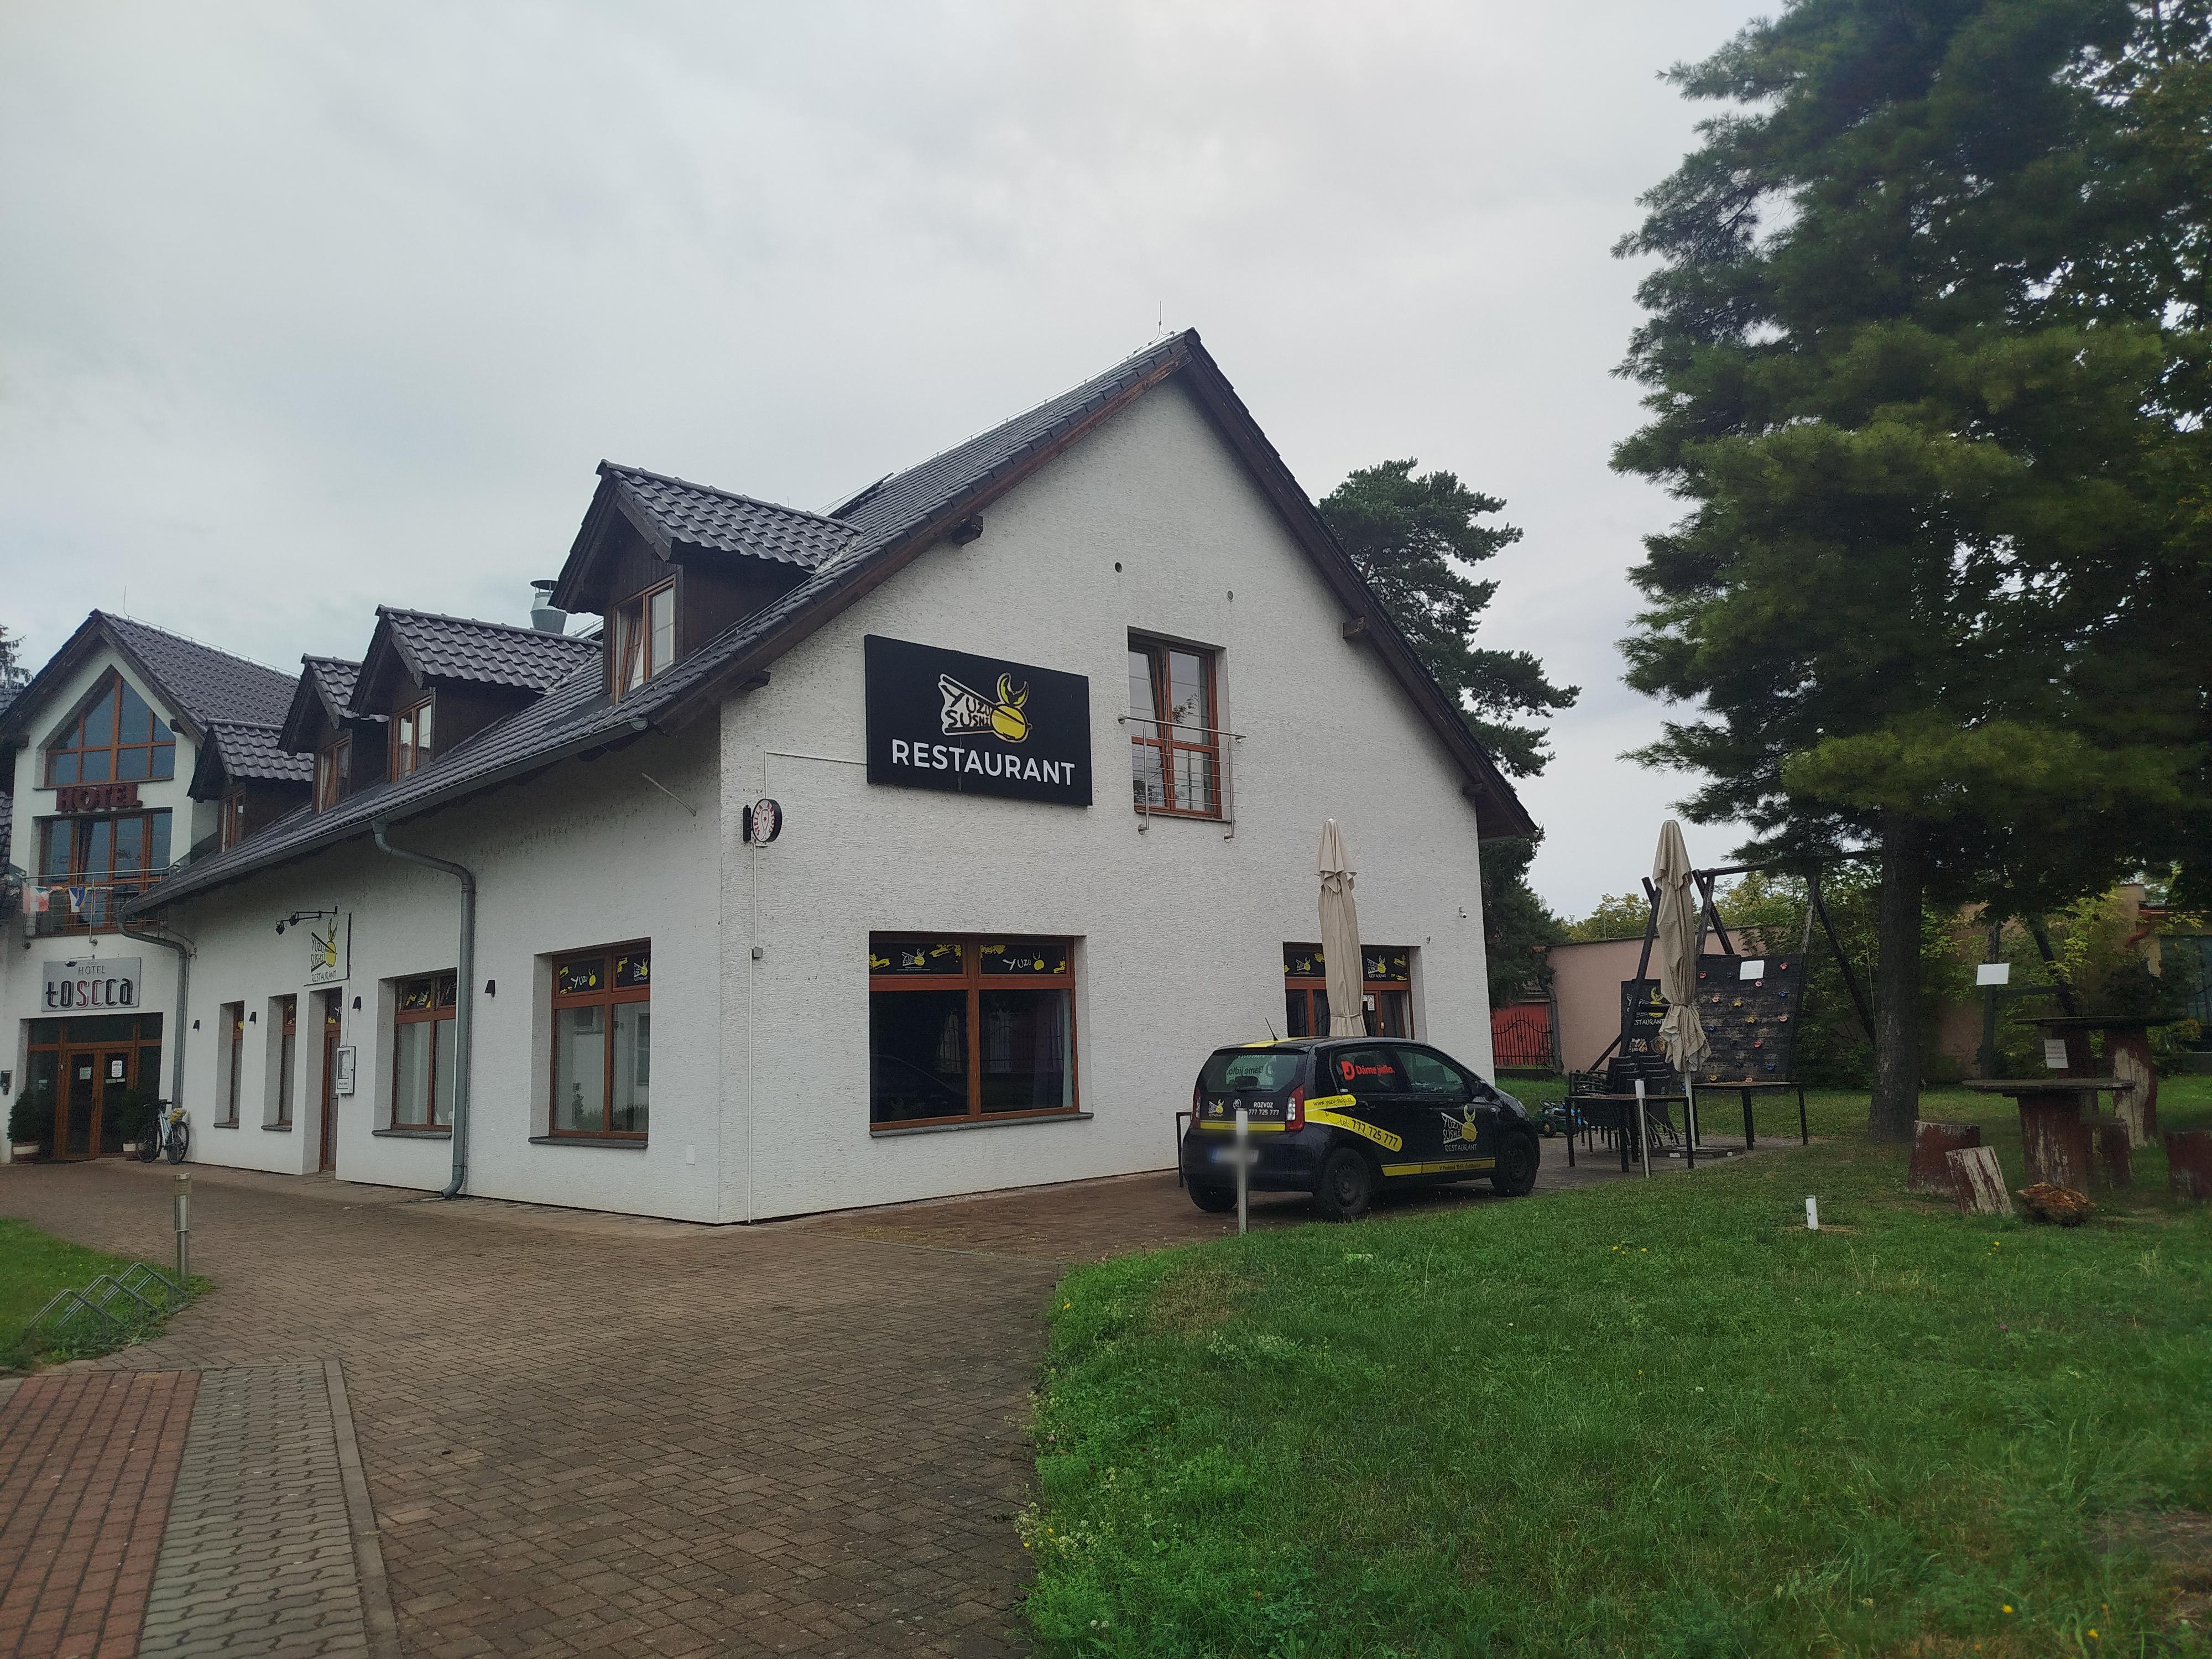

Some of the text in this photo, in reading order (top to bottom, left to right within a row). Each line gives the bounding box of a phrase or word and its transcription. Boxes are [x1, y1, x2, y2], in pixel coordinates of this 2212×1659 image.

[940, 685, 990, 717] YUZU
[945, 709, 990, 728] SUSHI
[892, 739, 1075, 785] RESTAURANT
[55, 784, 142, 812] HOTEL
[754, 805, 763, 836] STELLA
[311, 937, 325, 953] YUZU
[311, 954, 324, 968] SUSHI
[1003, 958, 1031, 971] YUZU
[78, 965, 106, 975] HOTEL
[311, 969, 337, 983] RESTAURANT
[45, 978, 133, 1009] toscca
[1442, 1116, 1462, 1130] YUZU
[1340, 1118, 1399, 1147] tel: 777 725 777
[1442, 1129, 1460, 1141] SUSHI
[1444, 1144, 1478, 1152] RESTAURANT
